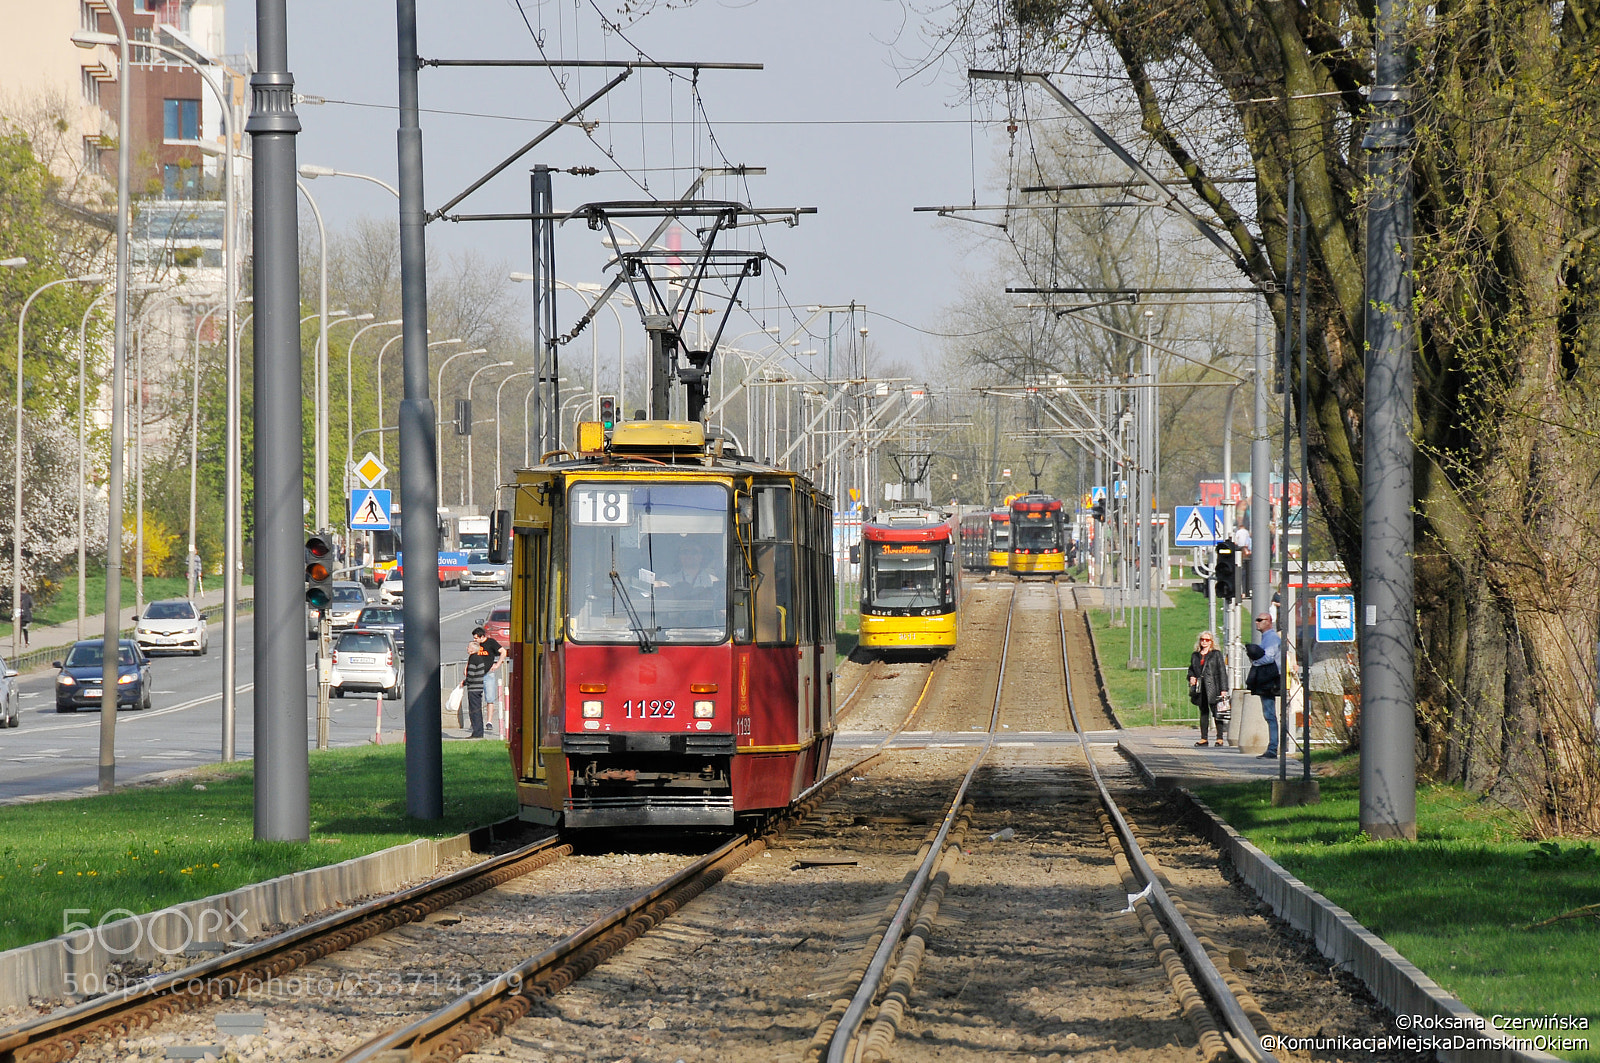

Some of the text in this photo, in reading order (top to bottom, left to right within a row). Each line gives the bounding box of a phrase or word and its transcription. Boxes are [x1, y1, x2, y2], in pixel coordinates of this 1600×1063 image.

[587, 489, 621, 522] 18
[882, 544, 890, 555] 31
[623, 699, 676, 719] 1122
[736, 717, 751, 736] 1122
